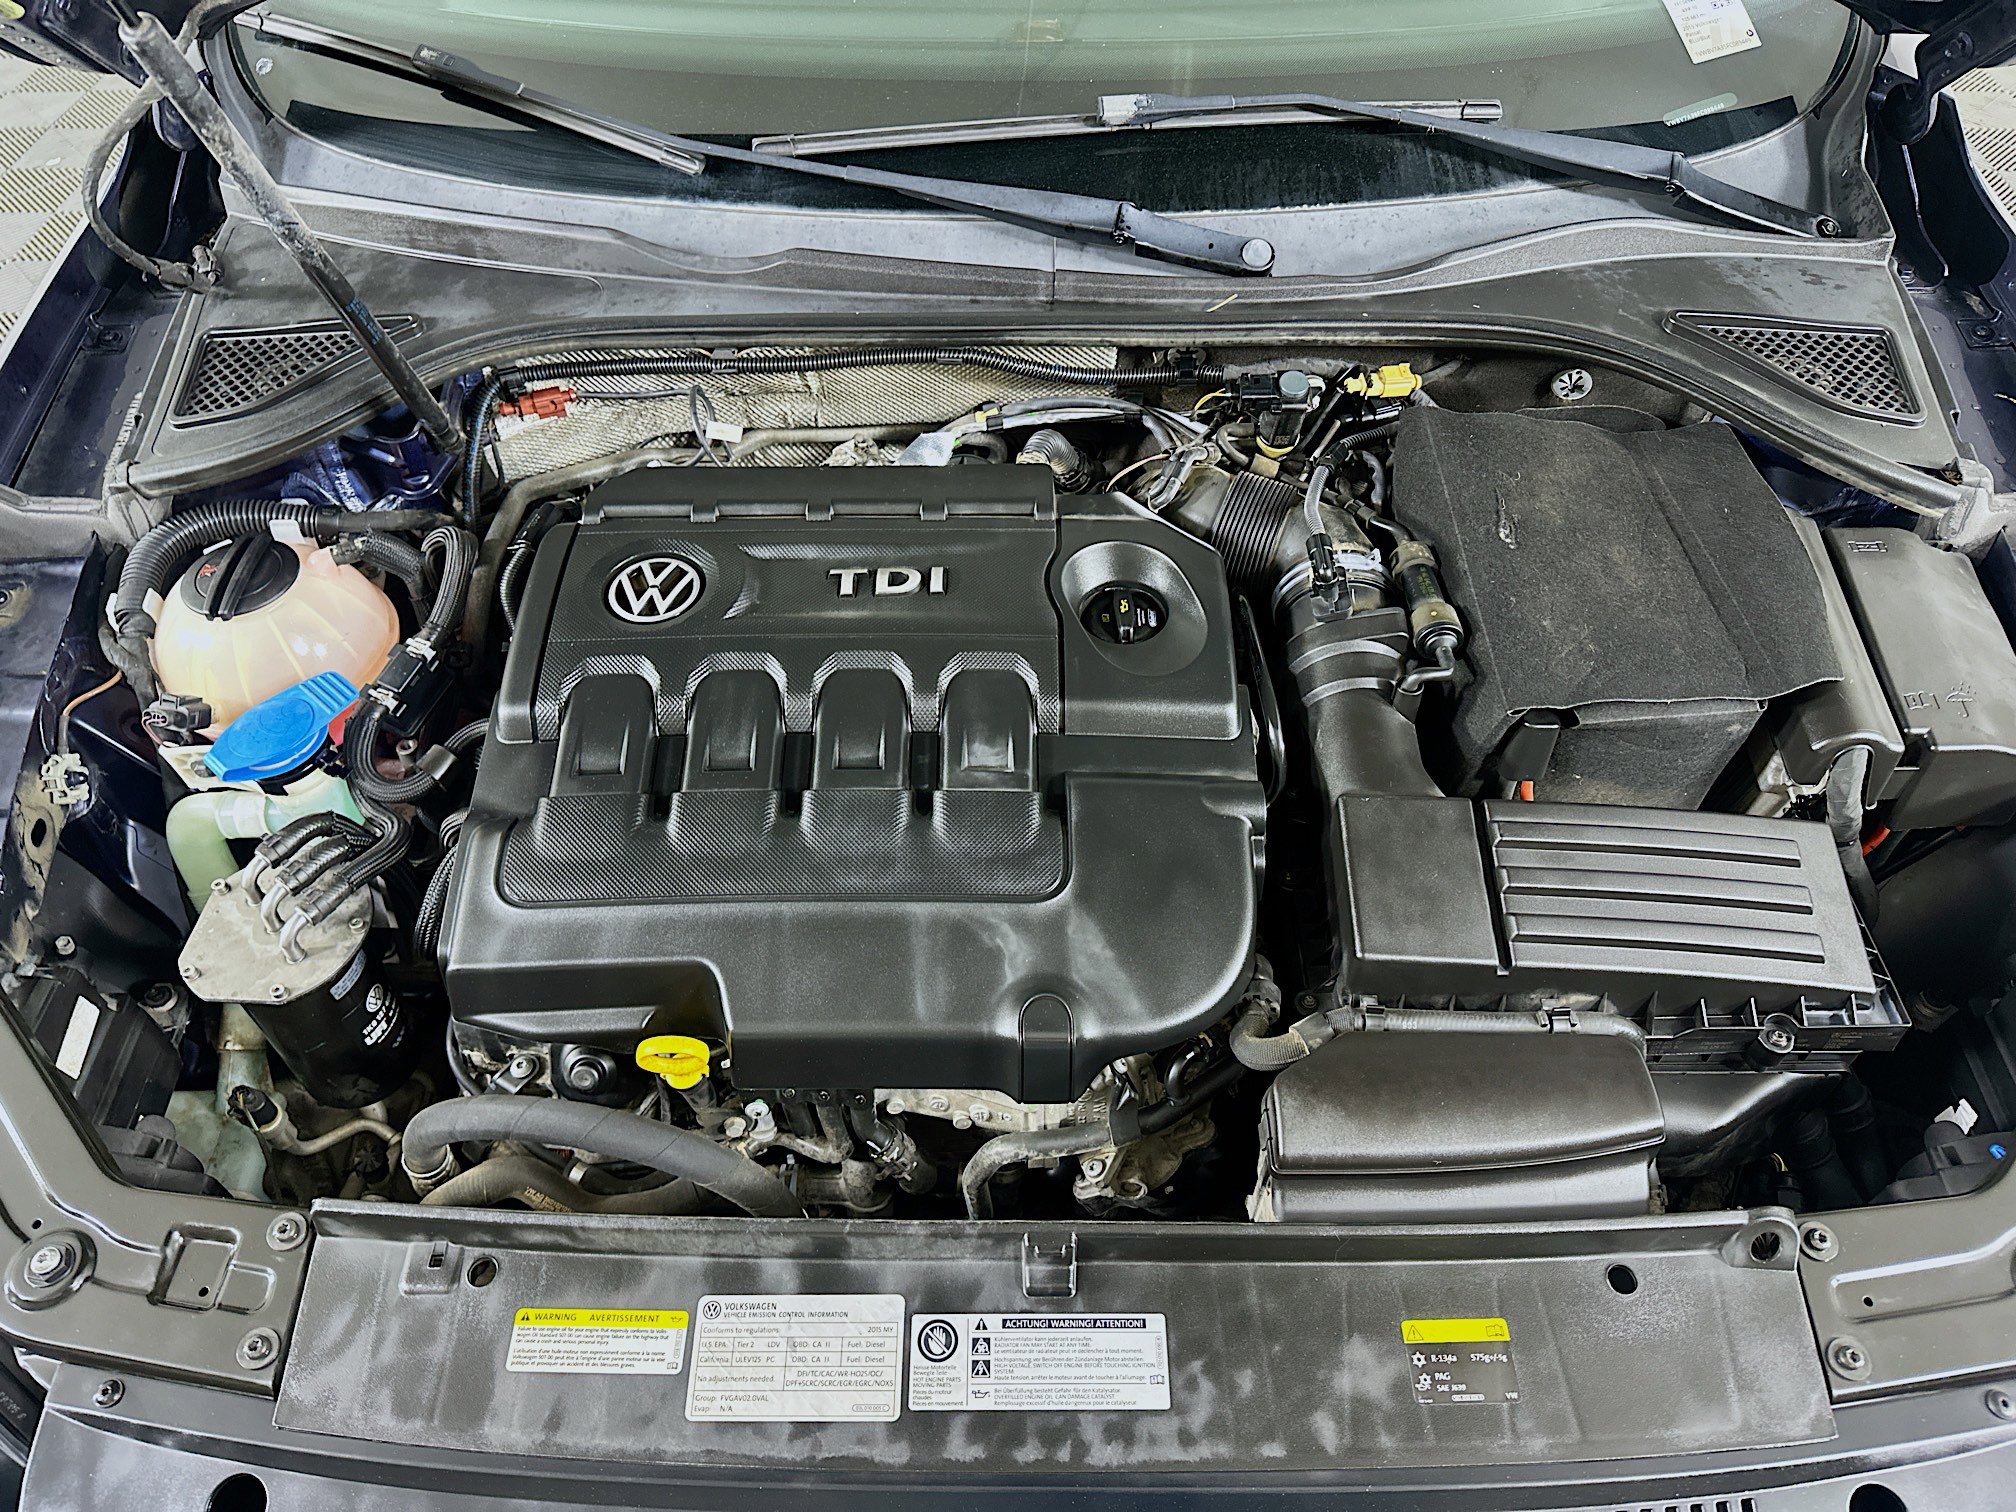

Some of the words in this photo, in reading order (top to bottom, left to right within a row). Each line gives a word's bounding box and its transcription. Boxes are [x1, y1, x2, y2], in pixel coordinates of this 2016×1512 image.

[829, 566, 948, 598] TDI
[534, 1313, 576, 1321] WARNING
[590, 1314, 660, 1322] AVERTISSEMENT
[1430, 1354, 1457, 1364] R-134a
[1435, 1372, 1451, 1380] PAG
